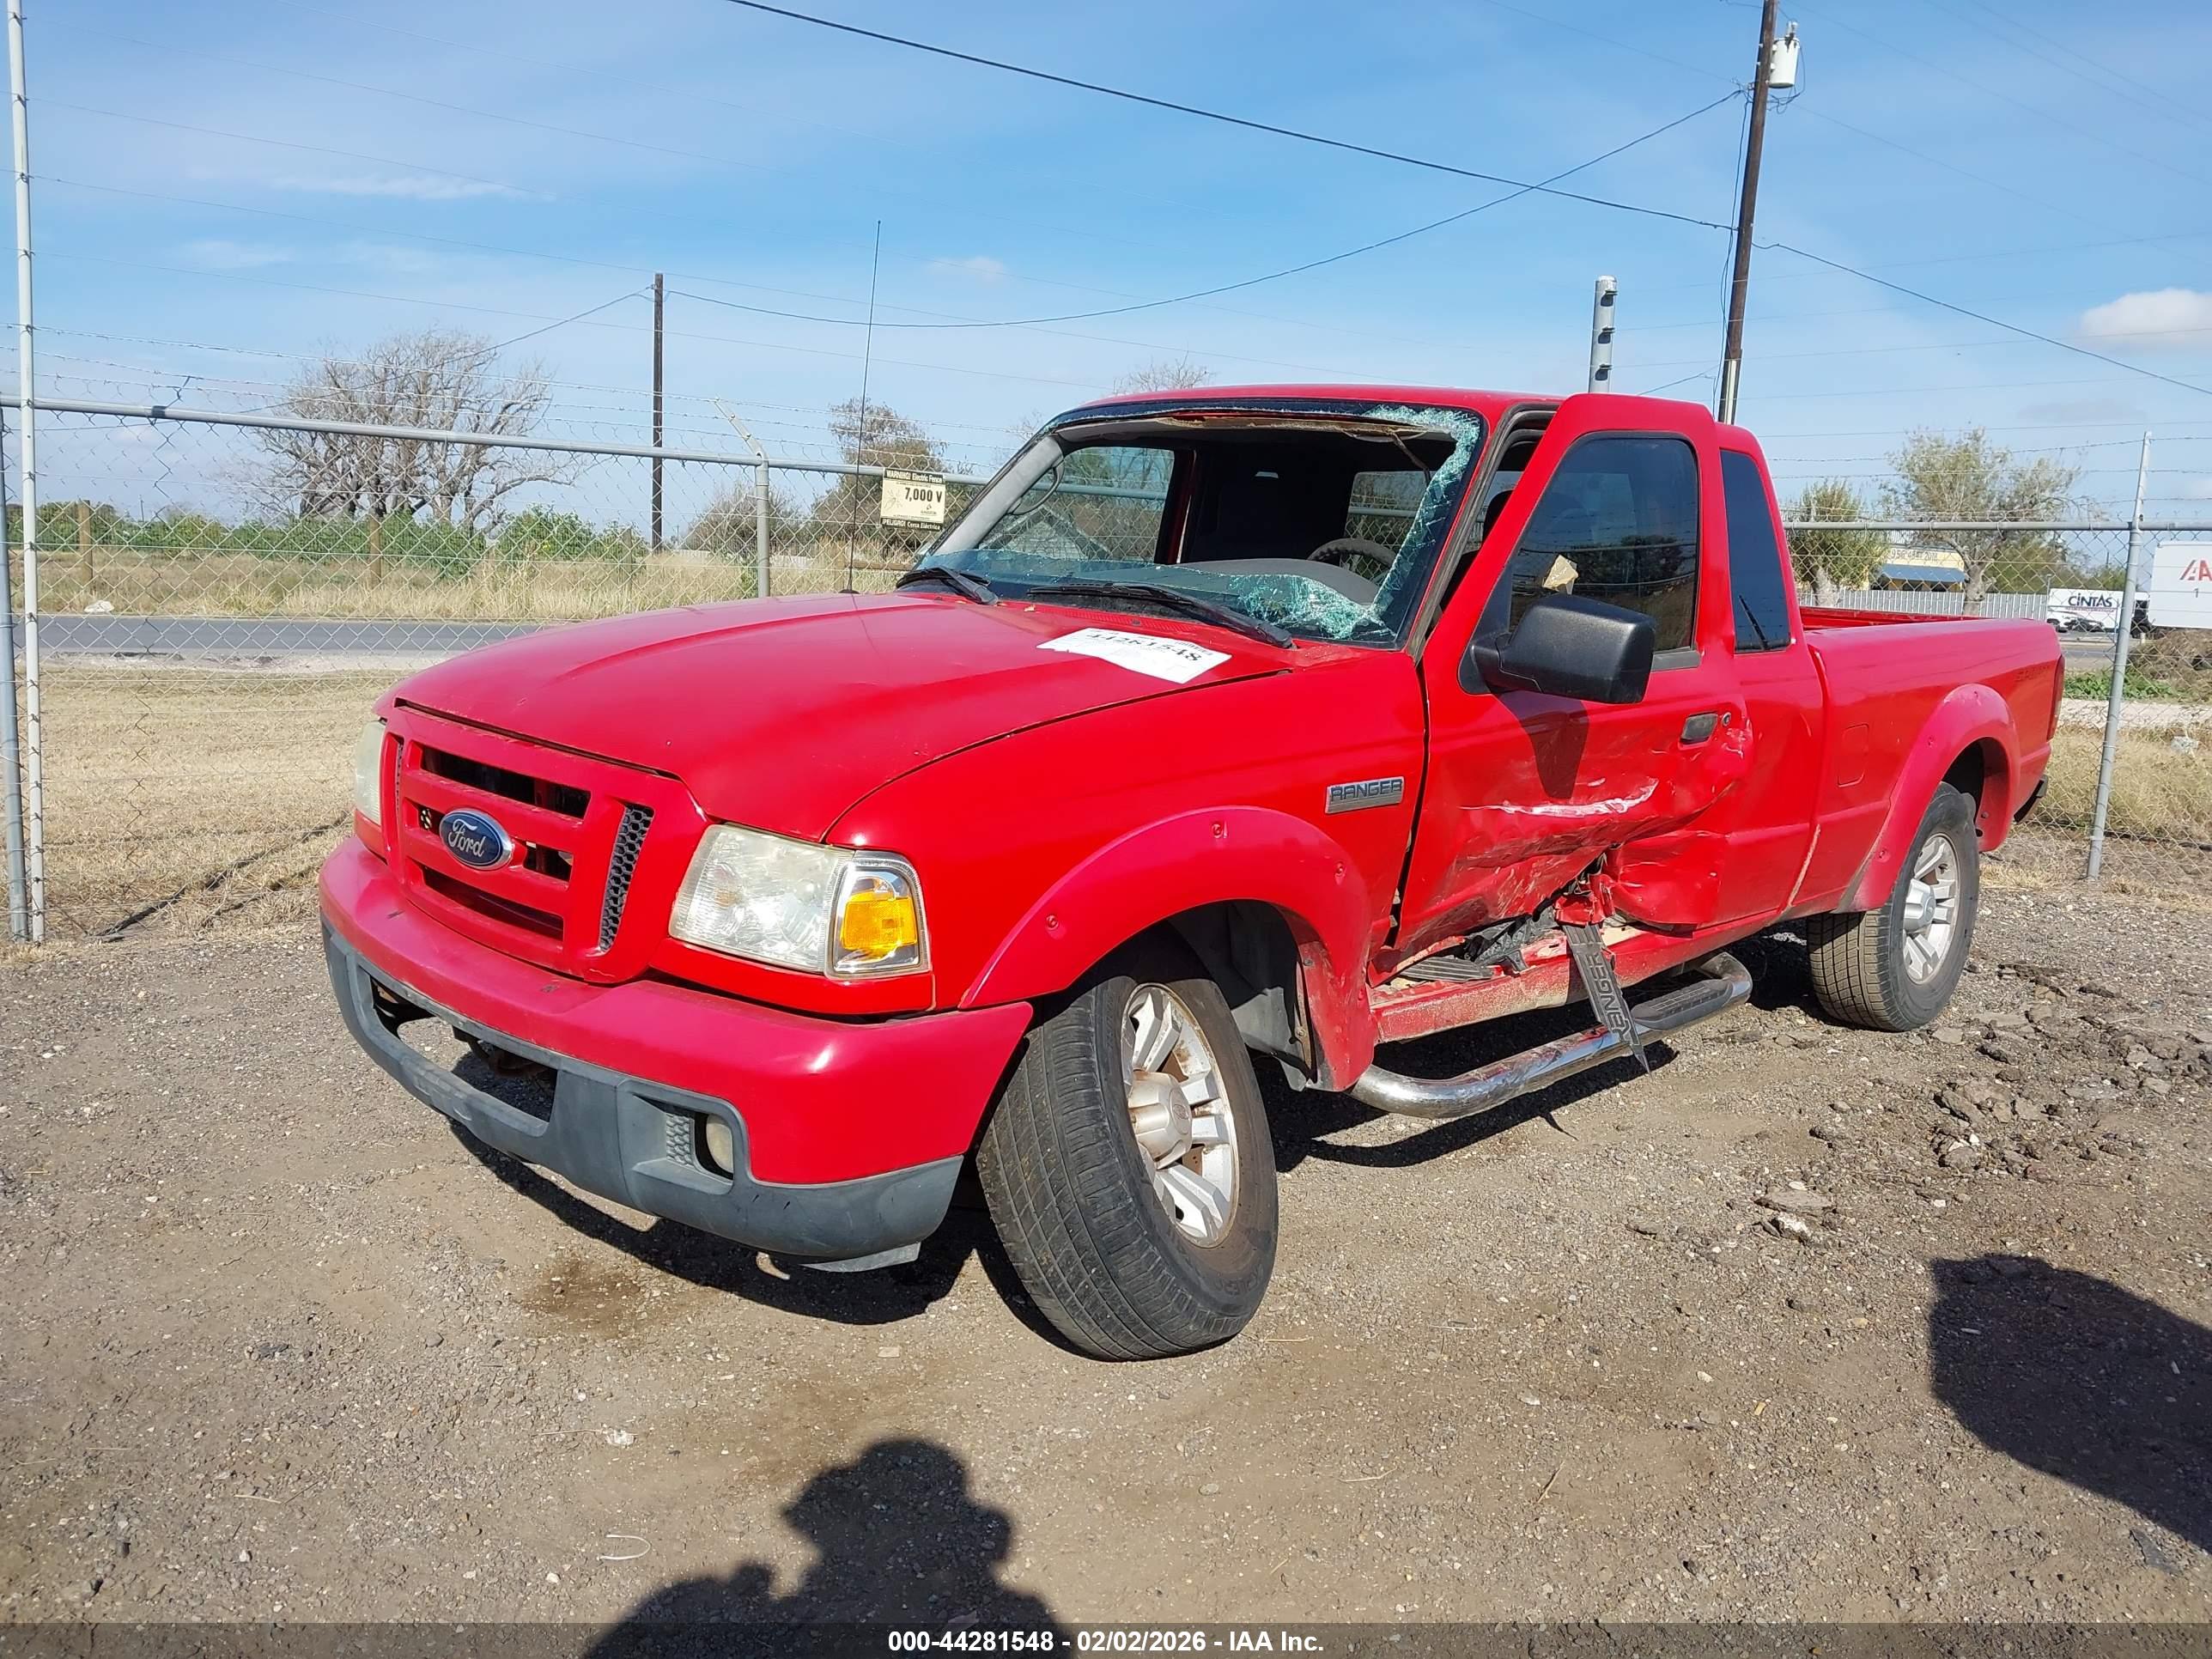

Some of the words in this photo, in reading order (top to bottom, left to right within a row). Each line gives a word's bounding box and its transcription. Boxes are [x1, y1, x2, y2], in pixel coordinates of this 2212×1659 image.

[886, 470, 910, 480] WARNING!
[912, 472, 928, 482] Electric
[929, 475, 943, 483] Fence
[904, 488, 933, 502] 7,000
[936, 490, 943, 503] V
[1330, 779, 1403, 802] RANGER
[448, 818, 486, 857] Ford
